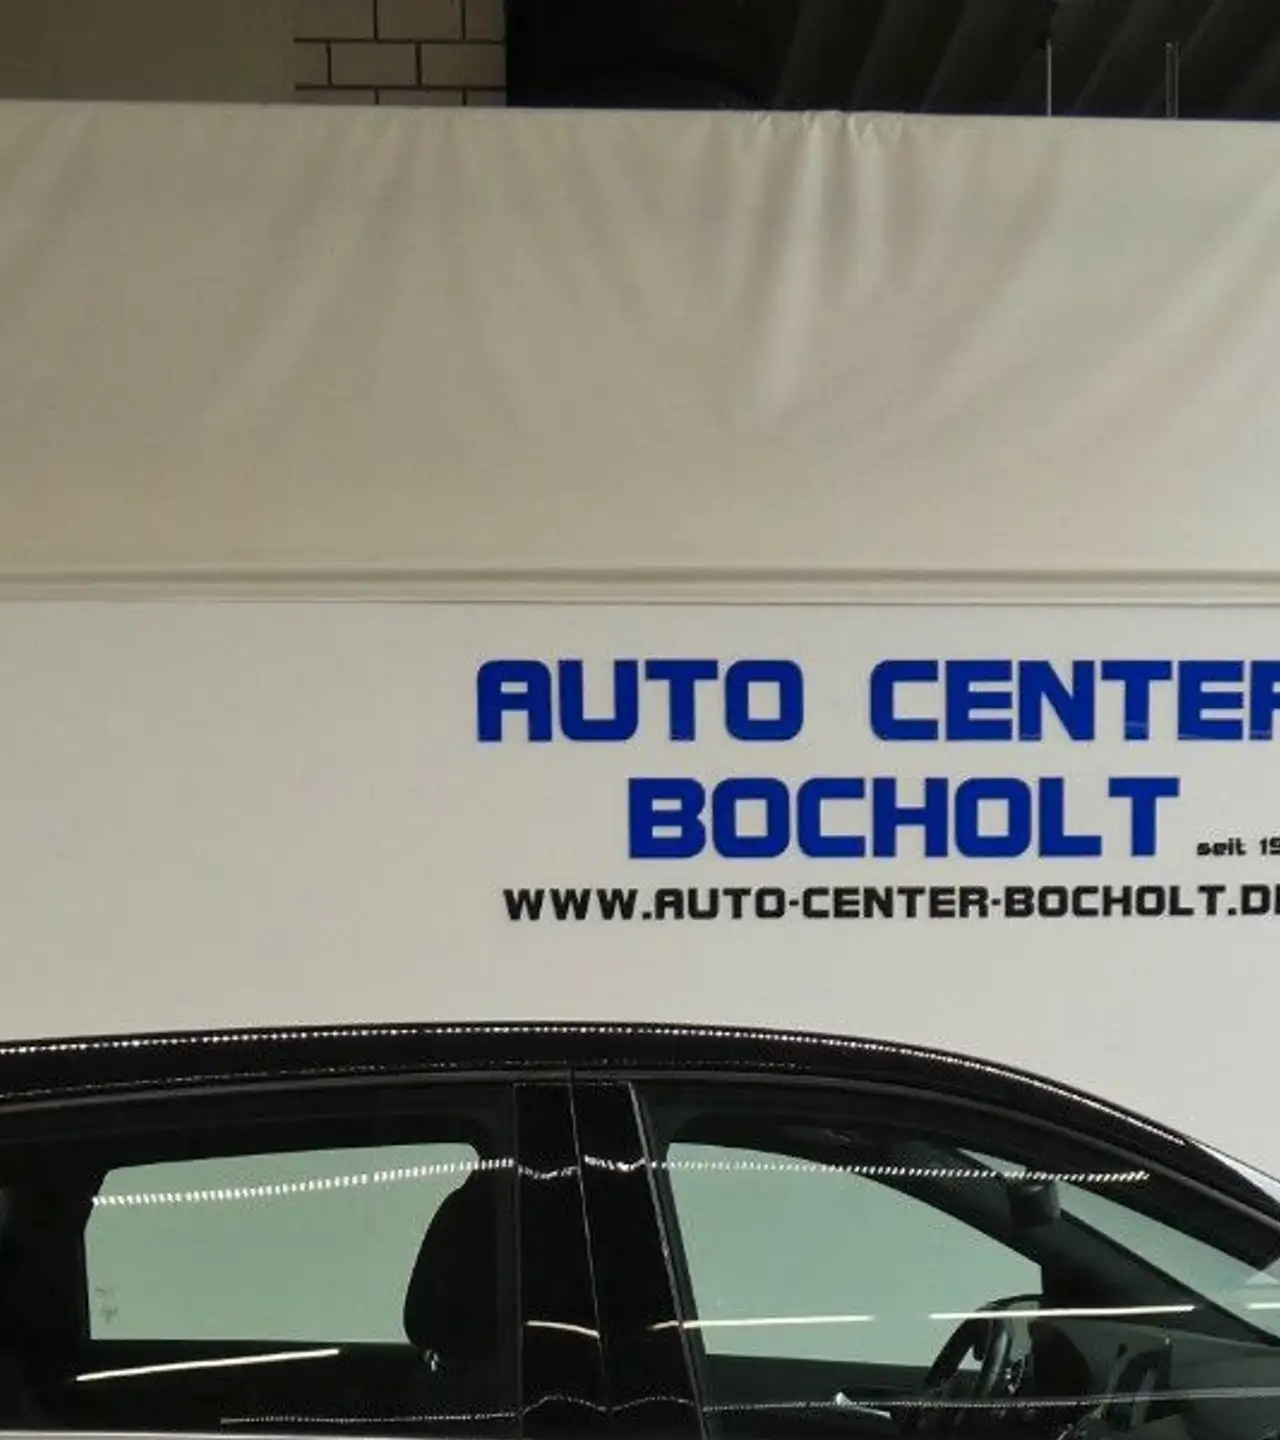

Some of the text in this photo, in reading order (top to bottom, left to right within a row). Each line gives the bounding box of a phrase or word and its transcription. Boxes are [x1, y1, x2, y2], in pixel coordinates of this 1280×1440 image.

[475, 658, 806, 743] AUTO
[627, 776, 1181, 860] BOCHOLT
[1196, 837, 1248, 857] seit
